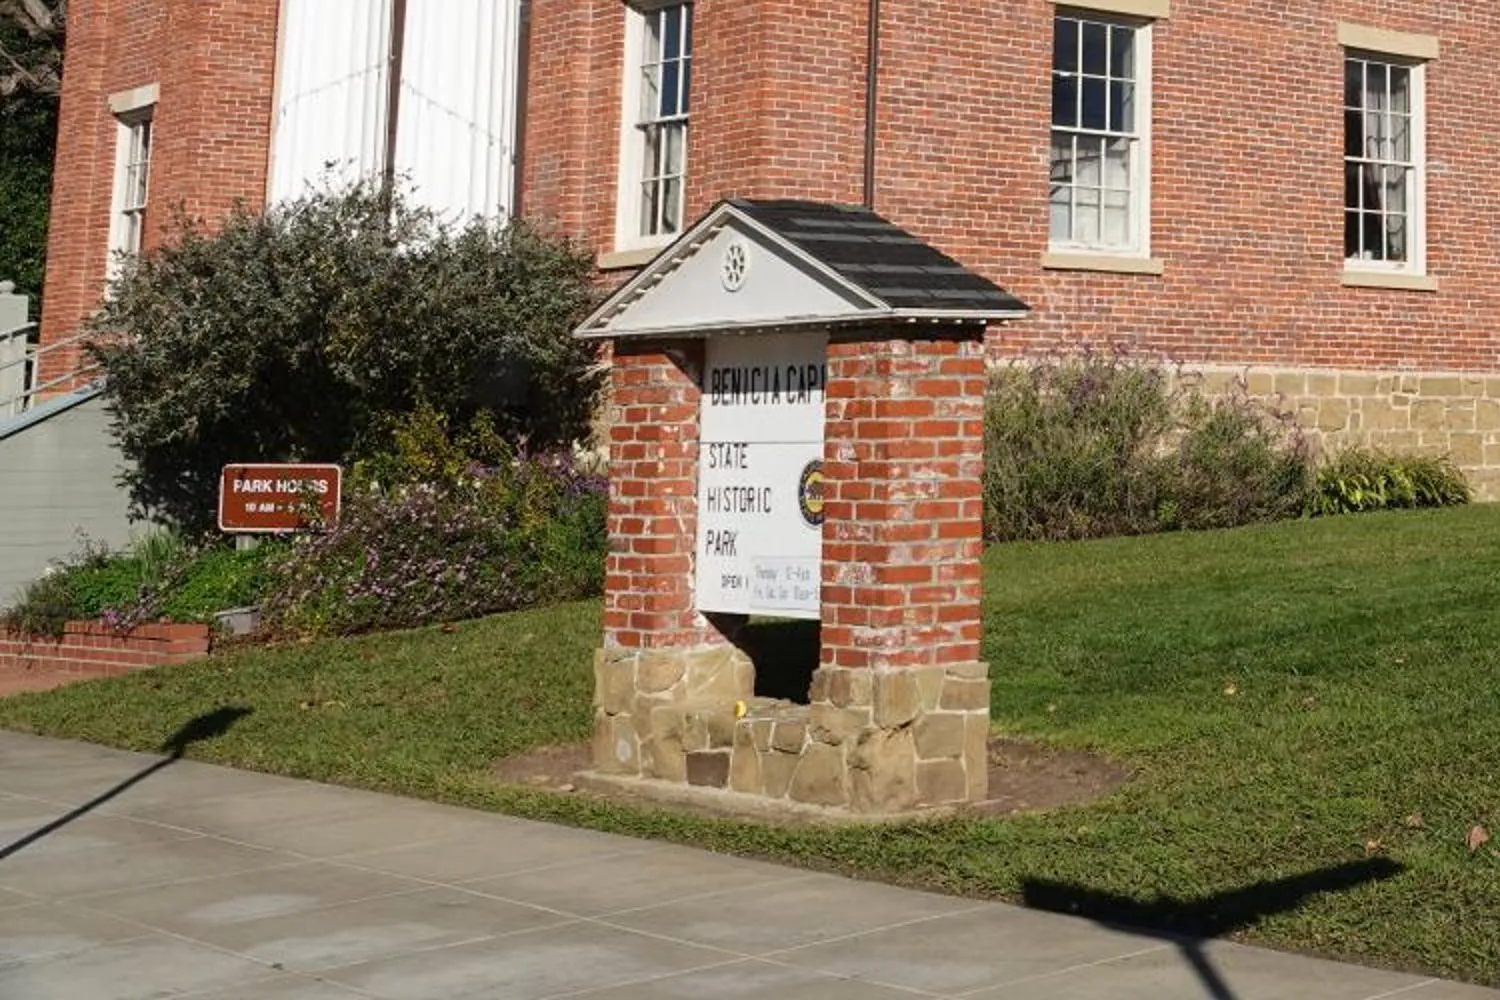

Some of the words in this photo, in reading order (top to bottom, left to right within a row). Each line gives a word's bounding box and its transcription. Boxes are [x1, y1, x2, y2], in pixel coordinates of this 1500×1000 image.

[711, 365, 781, 406] BENICIA
[708, 442, 749, 469] STATE
[233, 479, 273, 493] PARK
[276, 479, 329, 494] HOS
[707, 486, 772, 513] HISTORIC
[259, 503, 275, 513] AM
[705, 529, 738, 557] PARK
